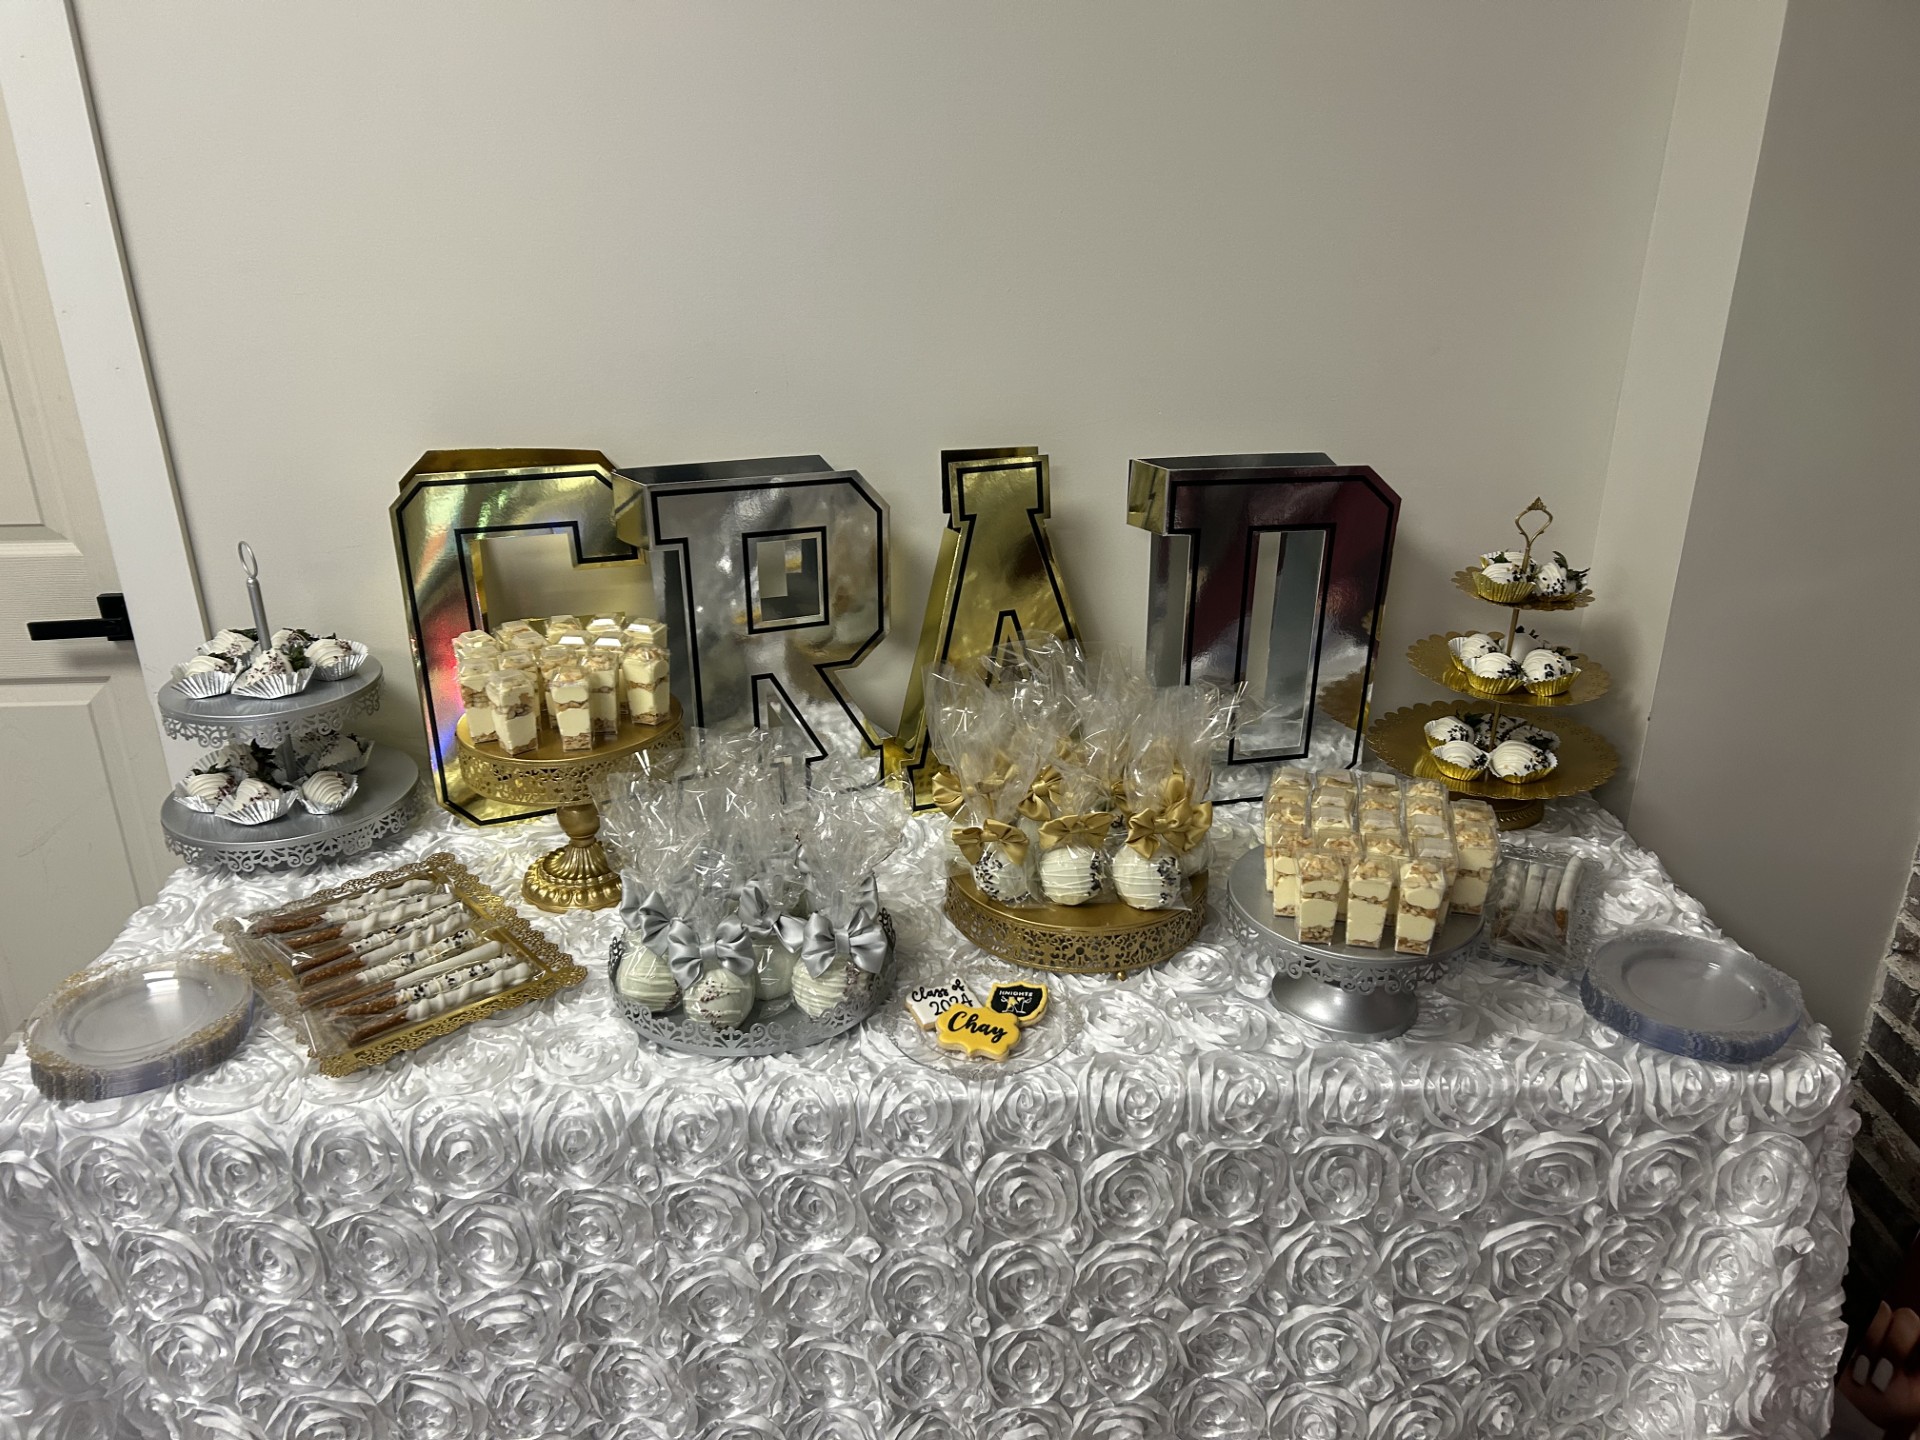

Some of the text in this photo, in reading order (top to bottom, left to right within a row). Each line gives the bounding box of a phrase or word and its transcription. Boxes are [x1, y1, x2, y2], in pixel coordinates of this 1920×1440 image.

[388, 448, 1402, 828] GRAD
[911, 978, 965, 1003] Class of
[947, 1010, 1008, 1044] Chay
